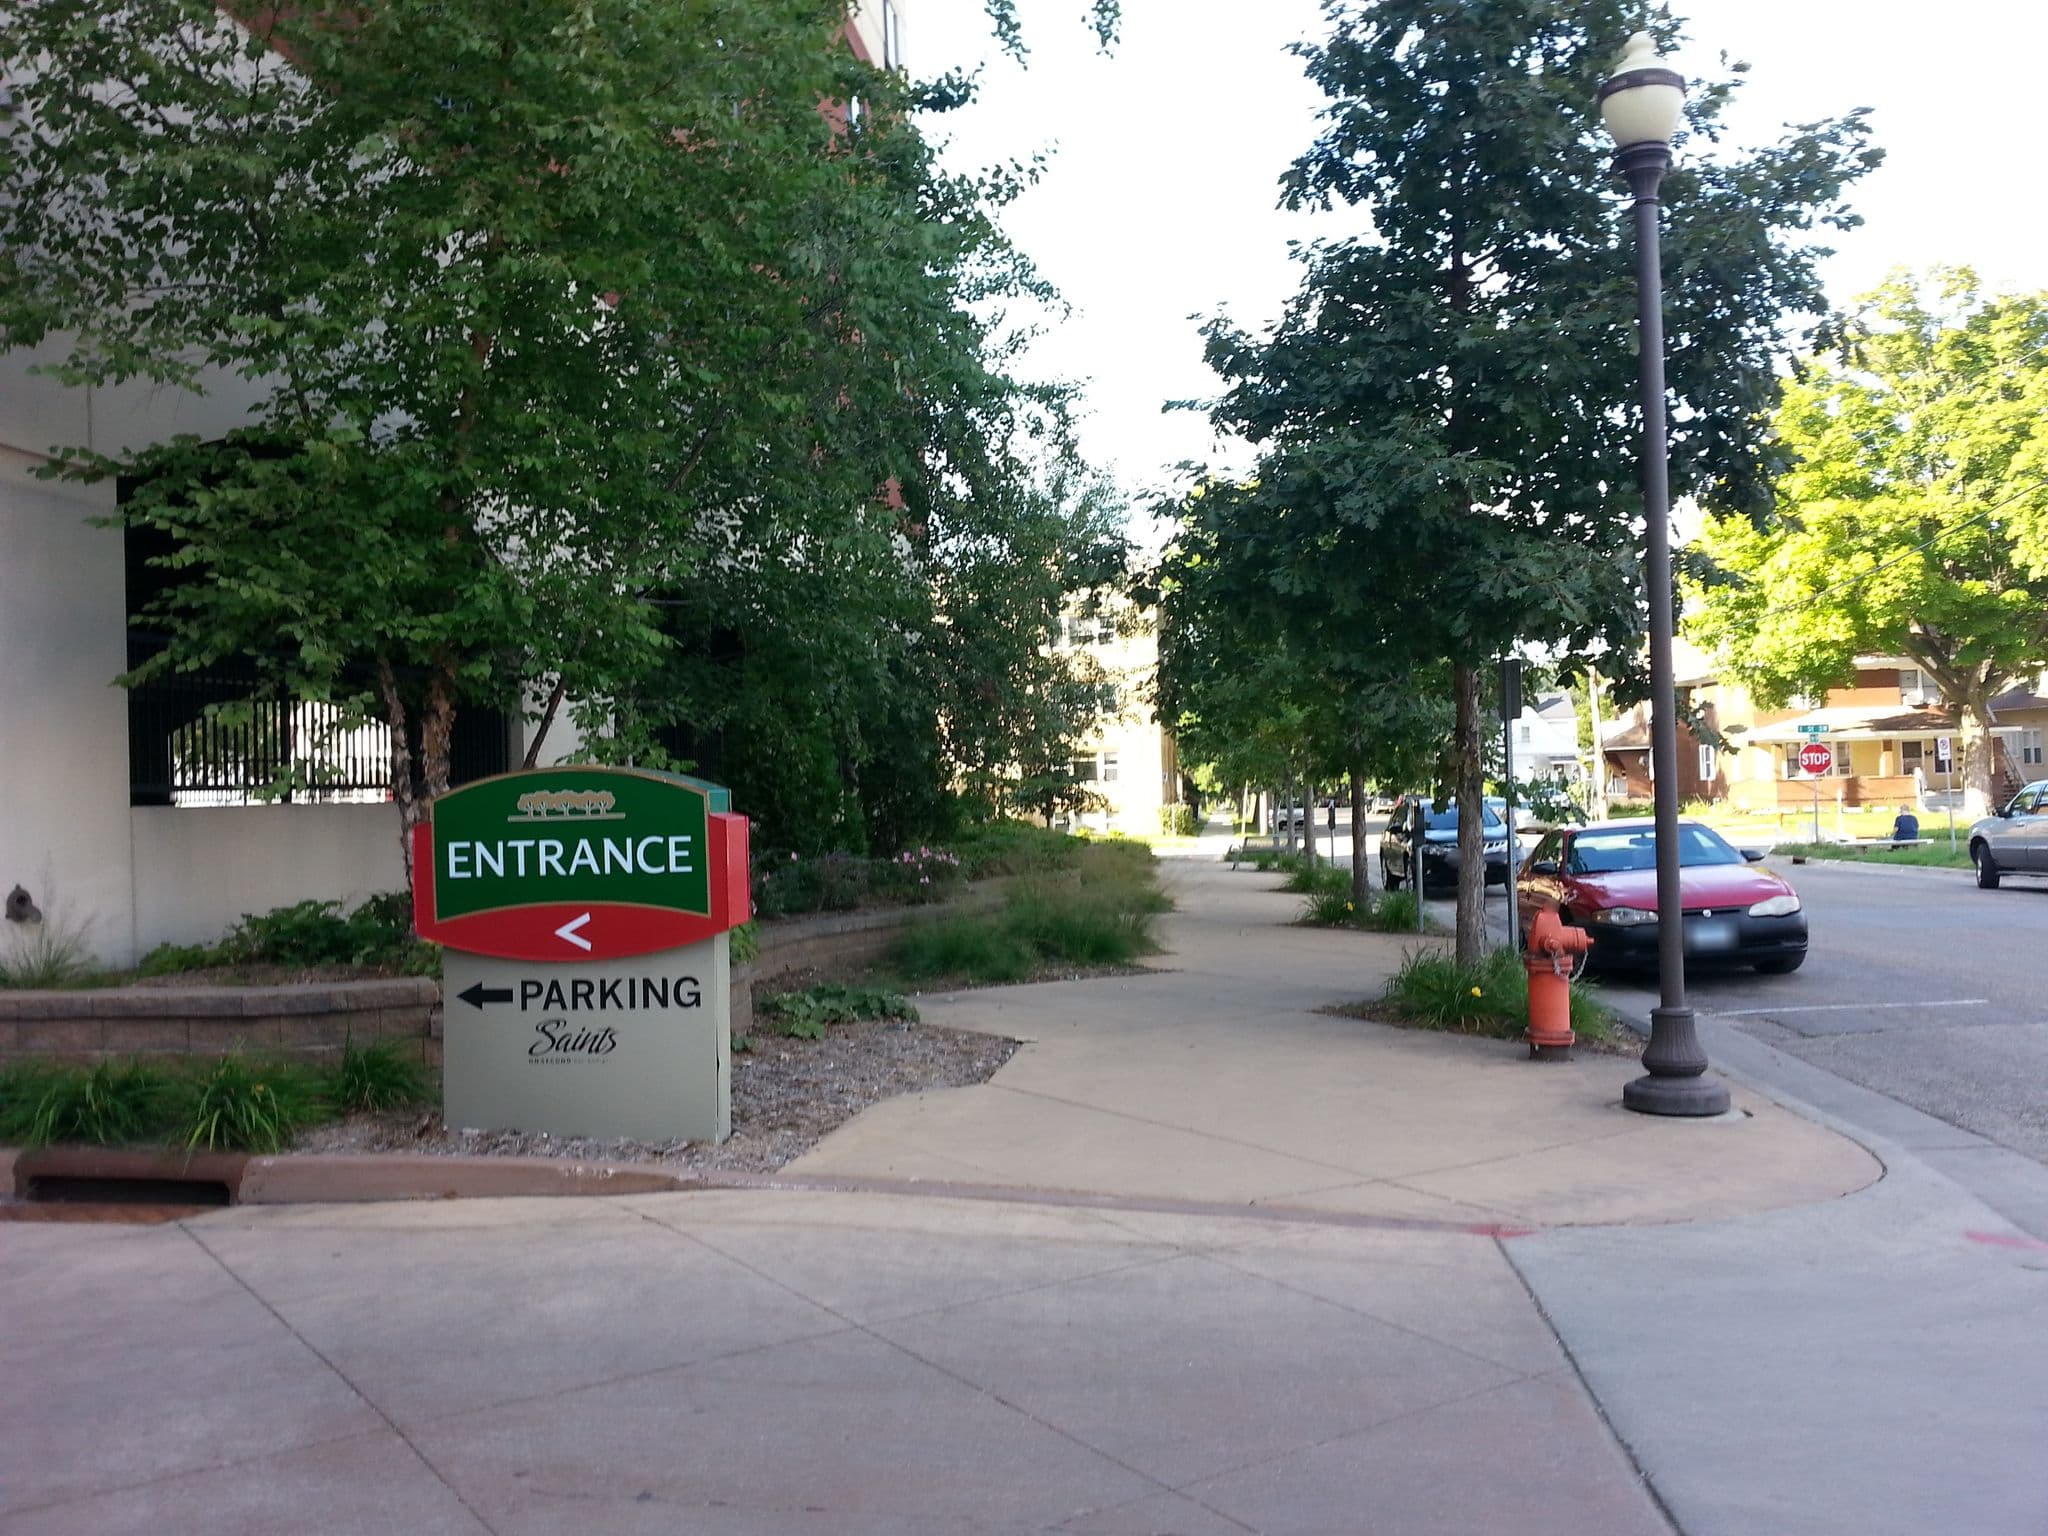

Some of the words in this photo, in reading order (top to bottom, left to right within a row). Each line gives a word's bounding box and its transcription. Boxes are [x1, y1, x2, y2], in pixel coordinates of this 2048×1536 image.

[1802, 752, 1830, 765] STOP
[448, 835, 693, 878] ENTRANCE
[520, 976, 701, 1011] PARKING
[528, 1018, 618, 1056] Saints
